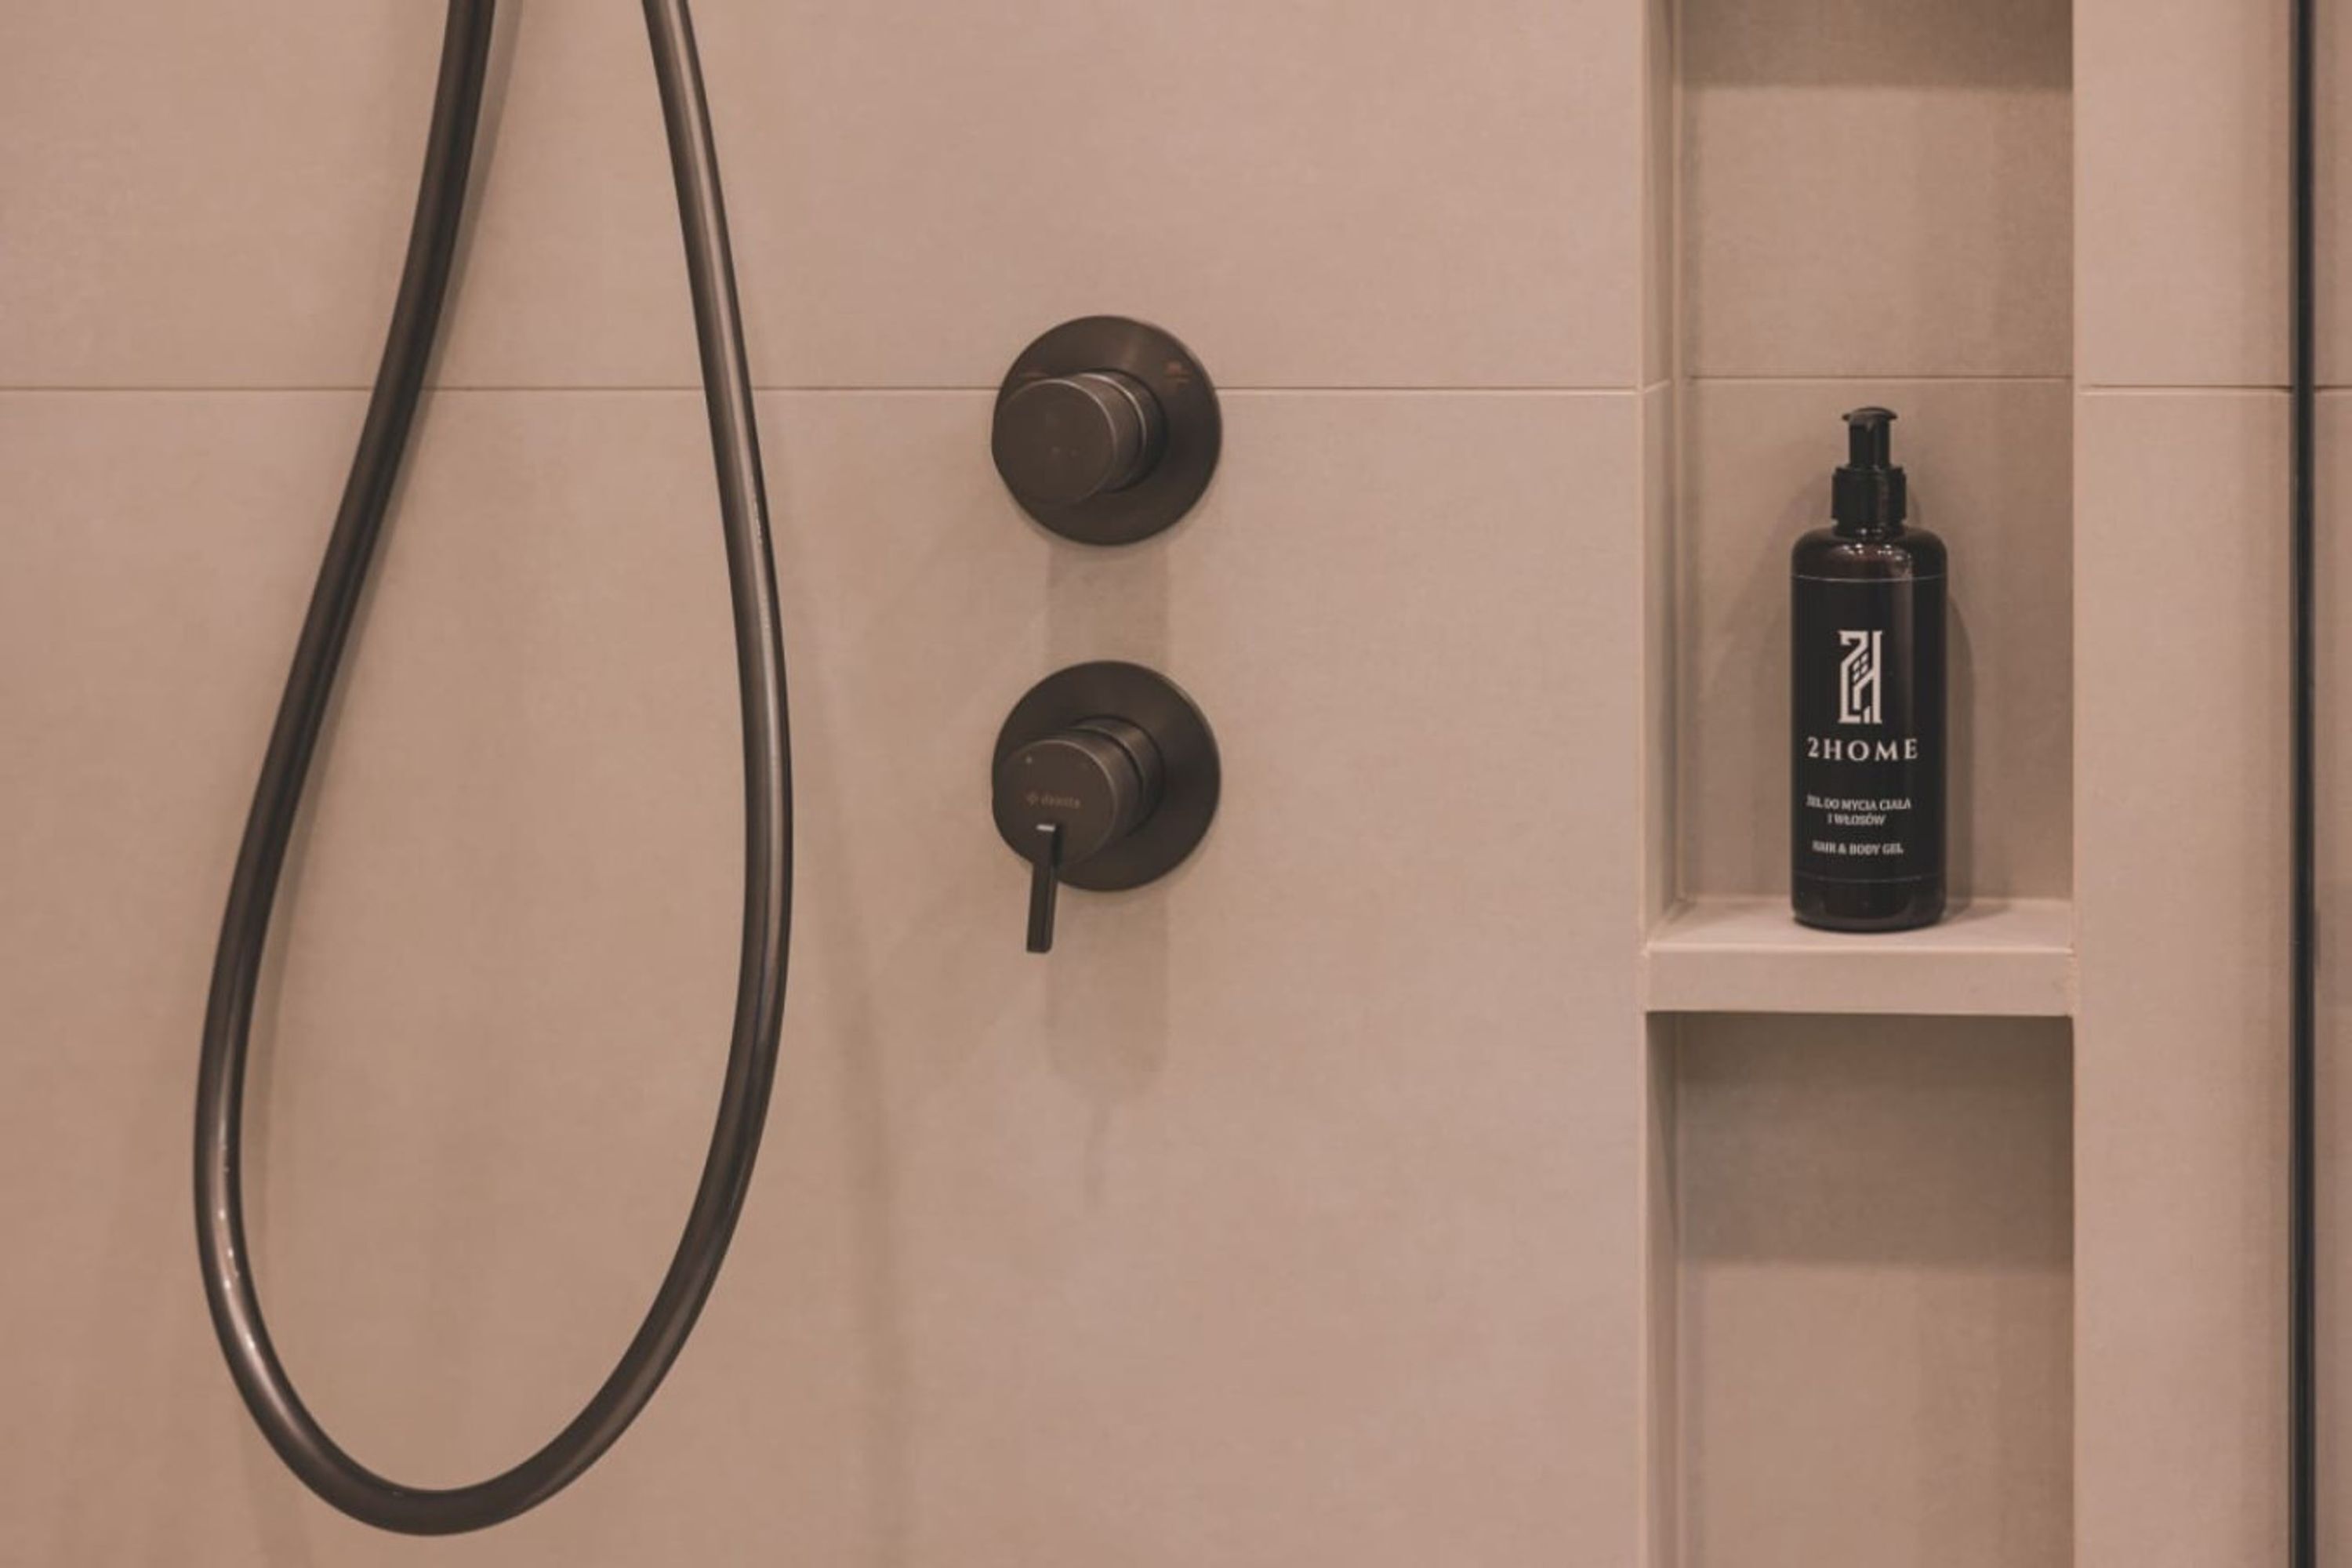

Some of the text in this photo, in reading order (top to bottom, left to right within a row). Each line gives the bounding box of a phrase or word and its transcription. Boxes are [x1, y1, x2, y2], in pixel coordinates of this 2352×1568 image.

[1807, 736, 1918, 762] 2HOME
[1824, 797, 1839, 809] DO
[1841, 798, 1877, 811] MYCIA
[1828, 813, 1832, 824] I
[1812, 840, 1836, 854] HAIR
[1849, 843, 1881, 855] BODY
[1882, 843, 1904, 855] GEL
